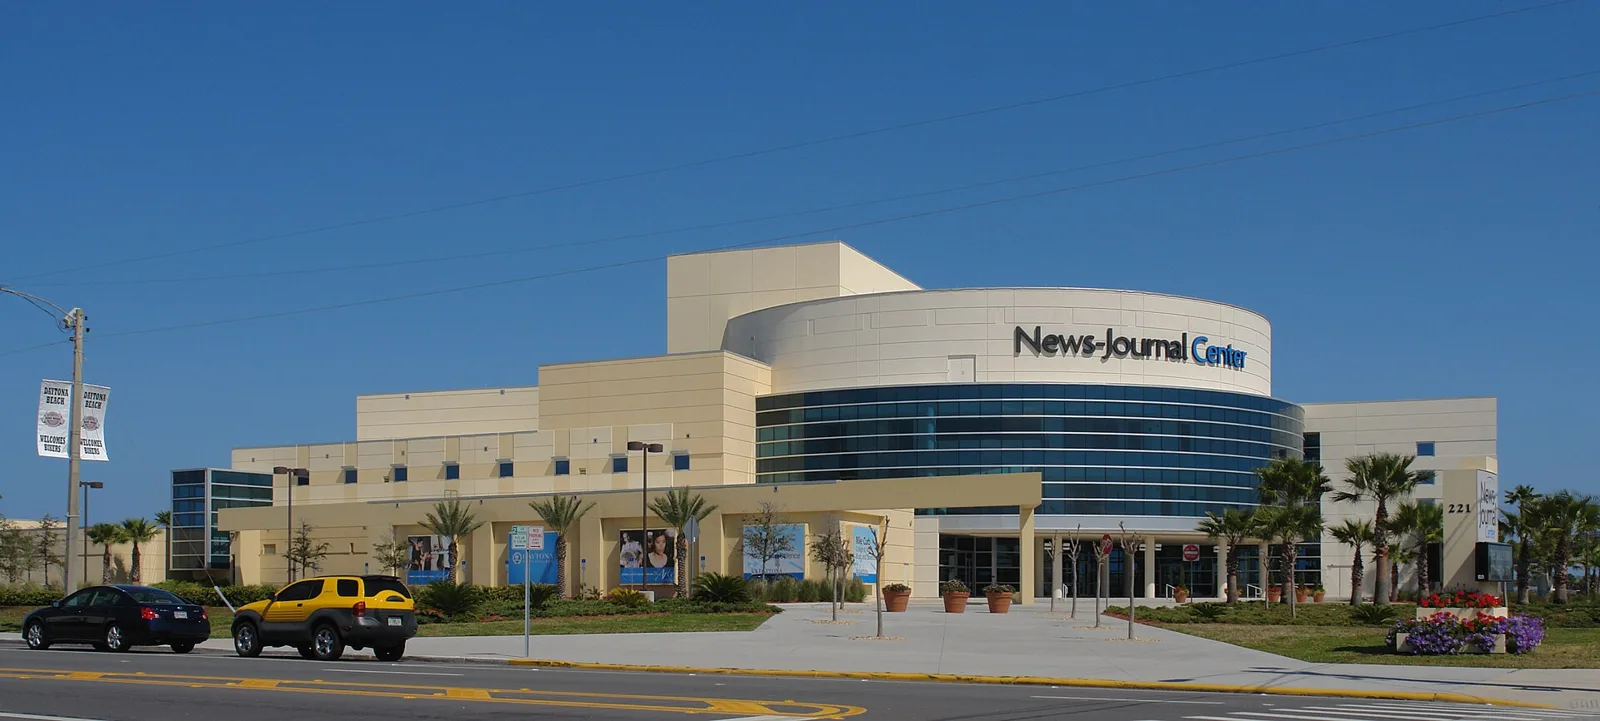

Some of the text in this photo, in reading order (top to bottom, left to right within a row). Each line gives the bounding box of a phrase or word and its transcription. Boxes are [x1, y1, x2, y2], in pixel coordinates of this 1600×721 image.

[1014, 325, 1247, 369] News-Journal Center
[44, 387, 69, 397] DAYTONA
[83, 391, 106, 401] DAYTONA
[46, 396, 65, 405] BEACH
[85, 400, 102, 409] BEACH
[40, 434, 66, 445] WELCOMES
[80, 438, 103, 447] WELCOMES
[44, 444, 61, 453] BIKERS
[84, 447, 100, 455] BIKERS
[1448, 504, 1471, 513] 221
[1478, 503, 1497, 528] Journal
